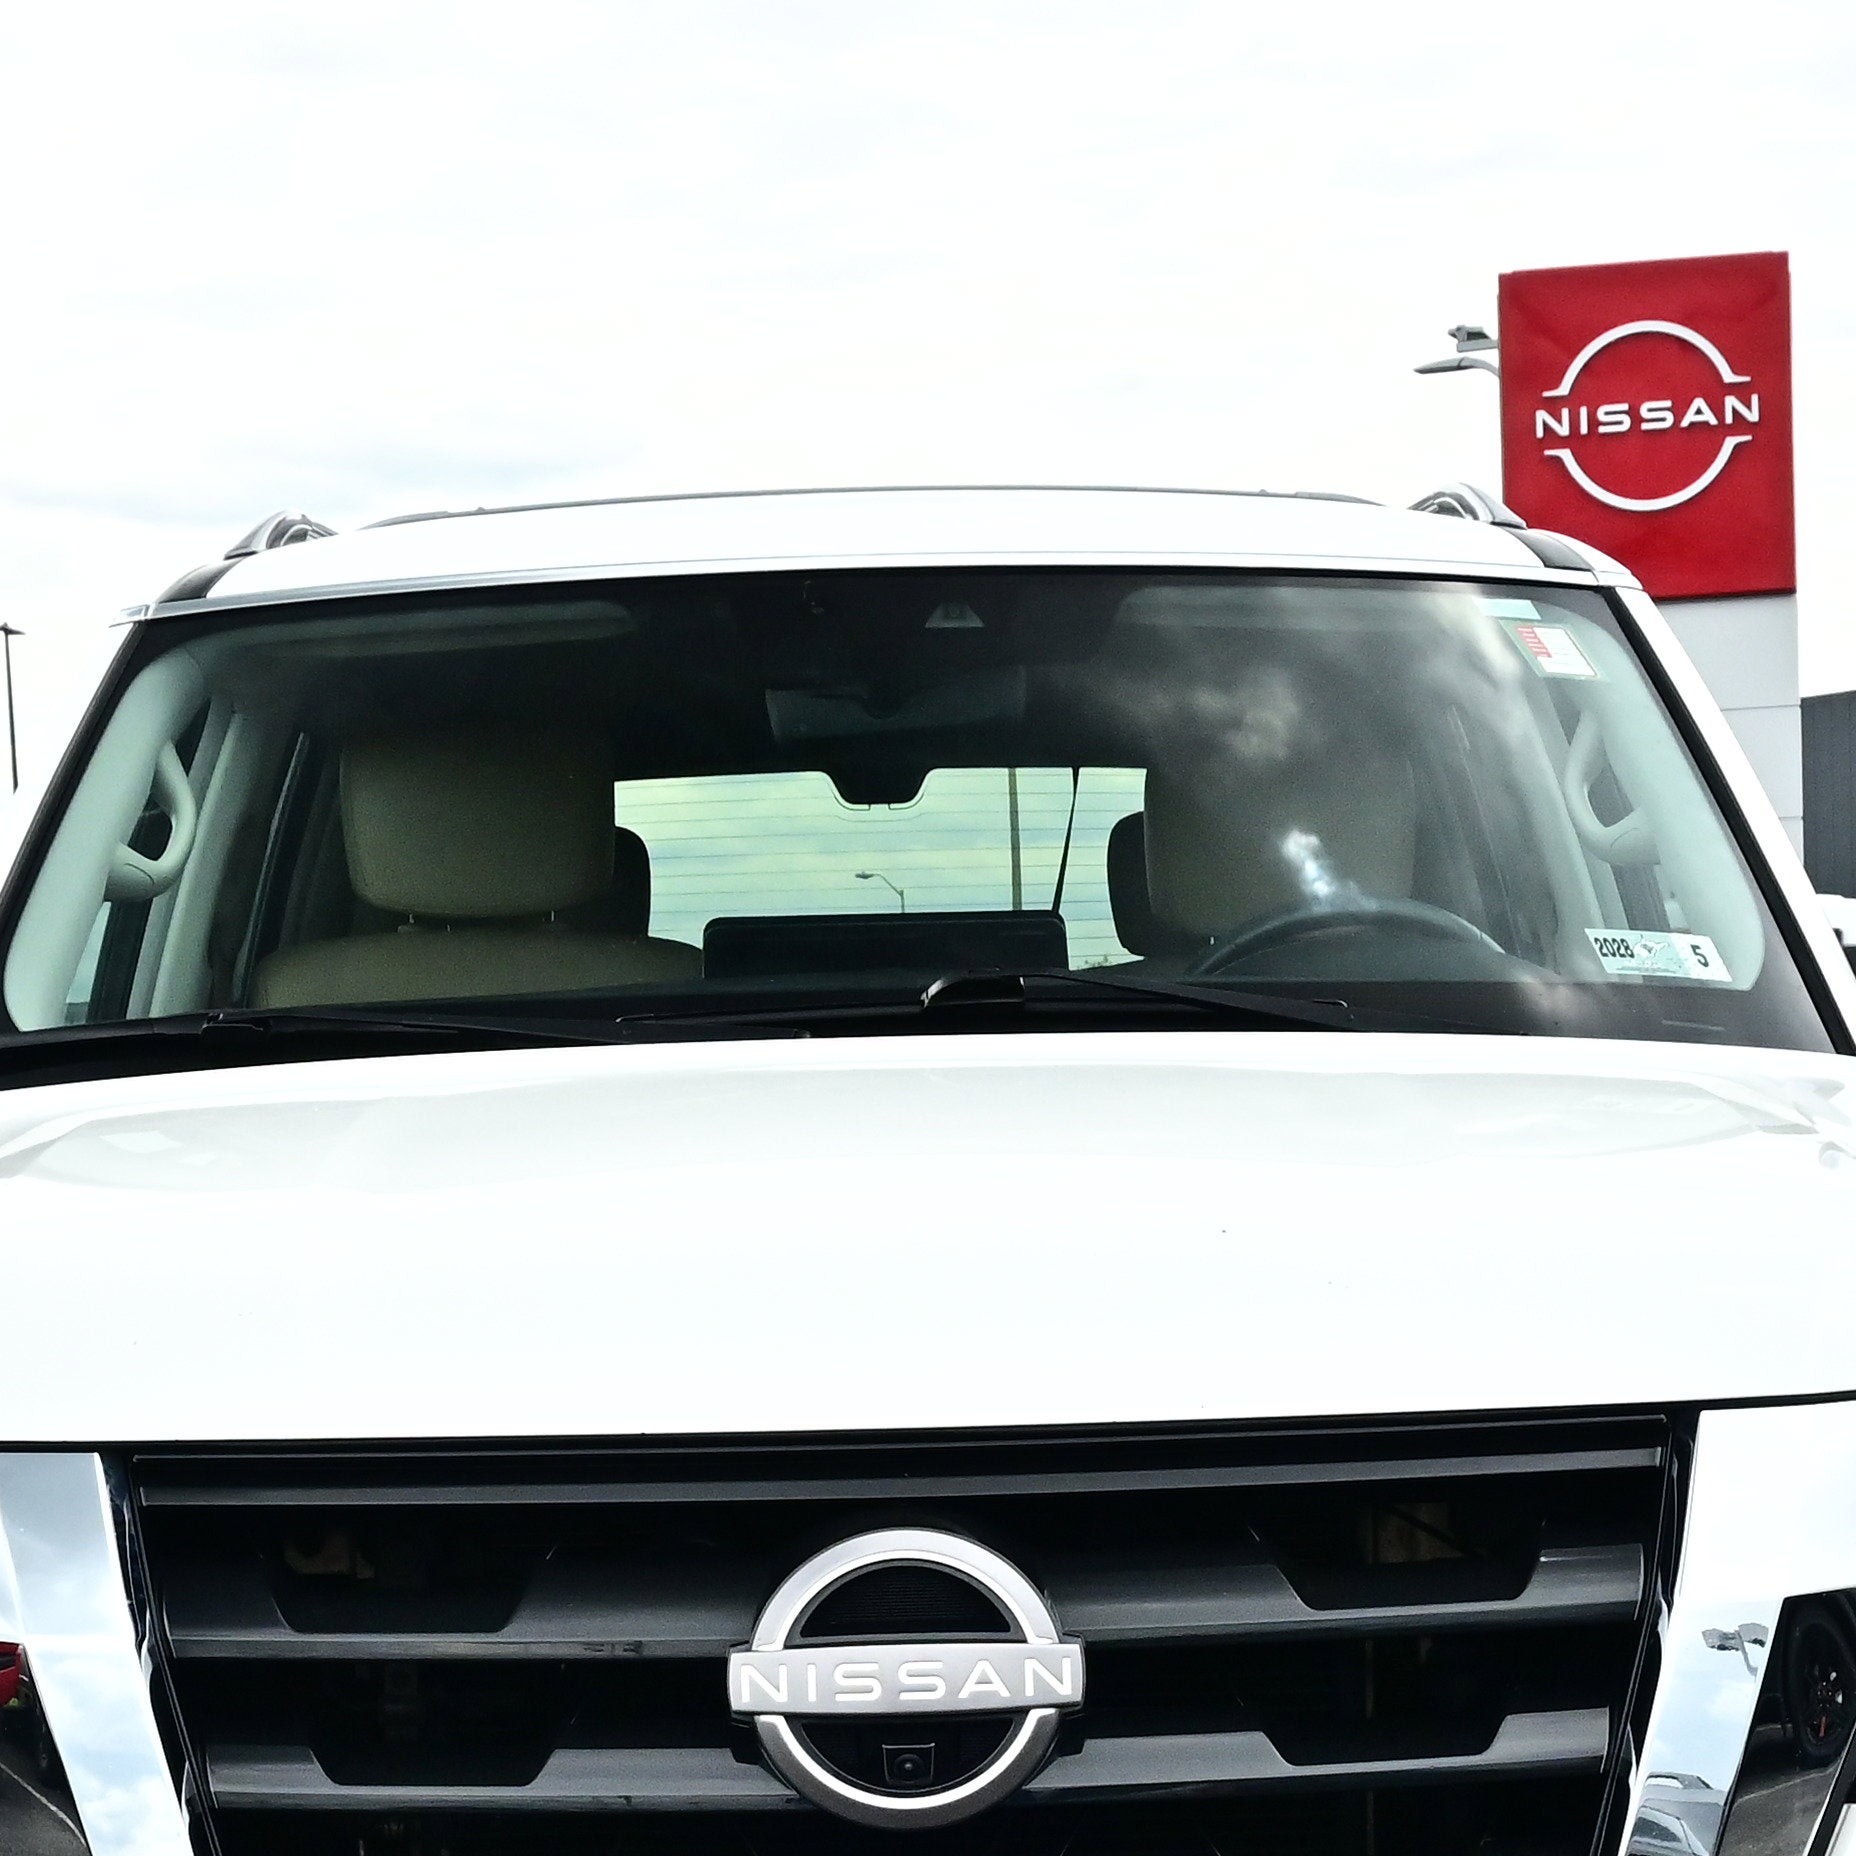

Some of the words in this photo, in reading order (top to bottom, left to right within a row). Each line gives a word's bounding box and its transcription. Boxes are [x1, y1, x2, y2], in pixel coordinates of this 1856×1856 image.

[1535, 393, 1760, 439] NISSAN
[1594, 937, 1635, 959] 2028
[1690, 944, 1710, 968] 5
[740, 1656, 1072, 1703] NISSAN
